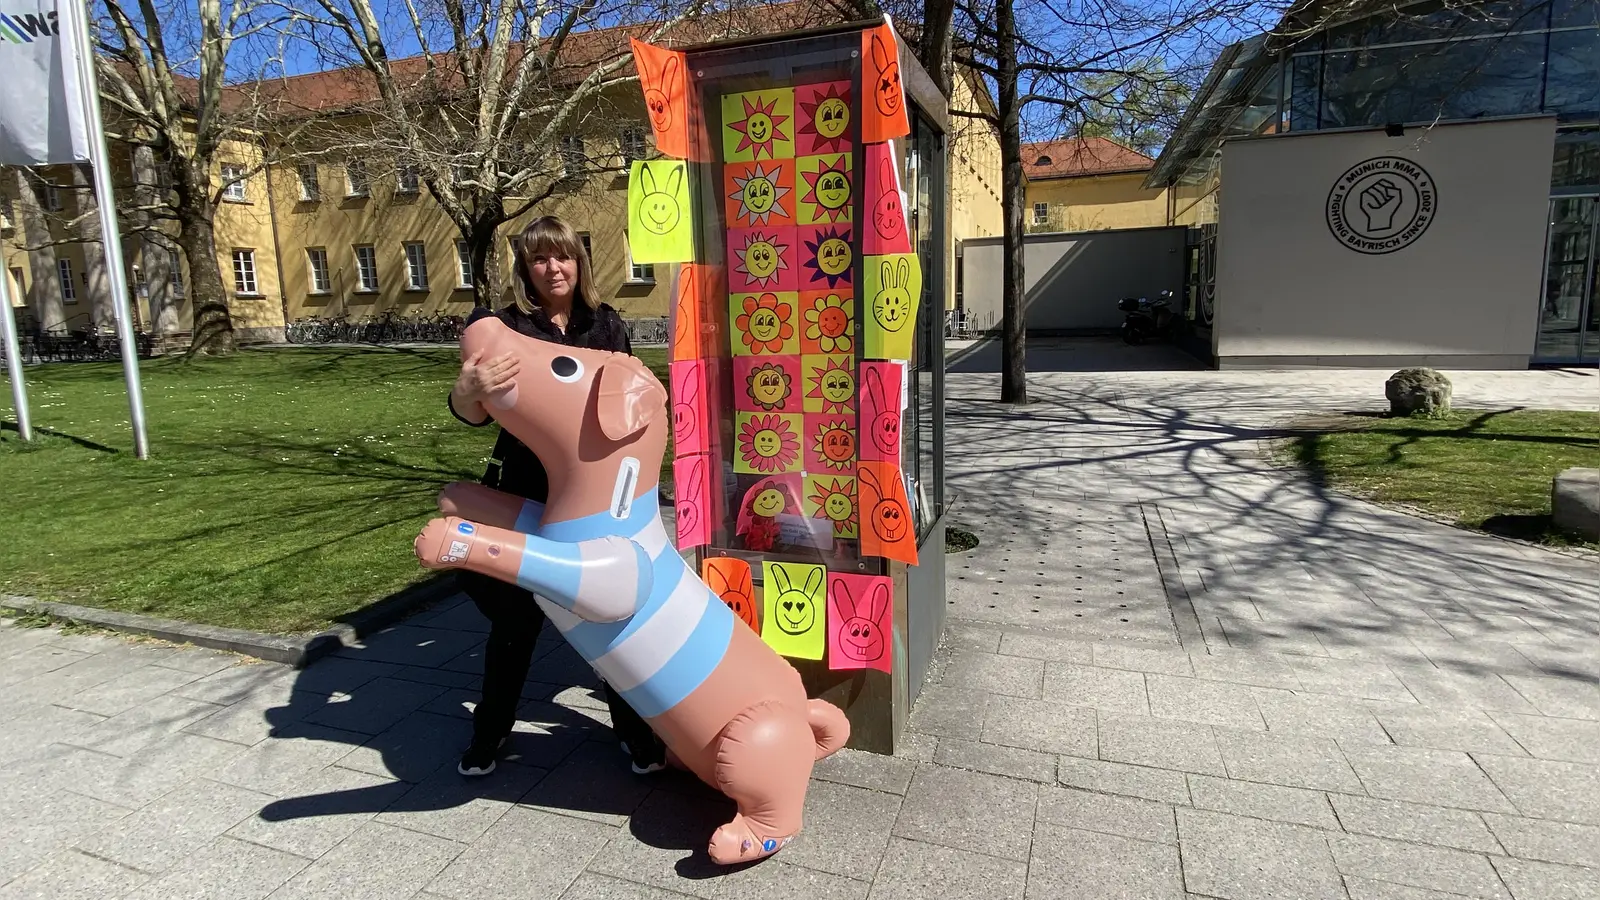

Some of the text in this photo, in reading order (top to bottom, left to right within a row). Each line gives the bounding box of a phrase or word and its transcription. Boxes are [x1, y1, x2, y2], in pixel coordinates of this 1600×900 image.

[1346, 161, 1420, 183] MUNICH MMA
[1331, 190, 1431, 250] FIGHTING BAYRISCH SINCE 2007
